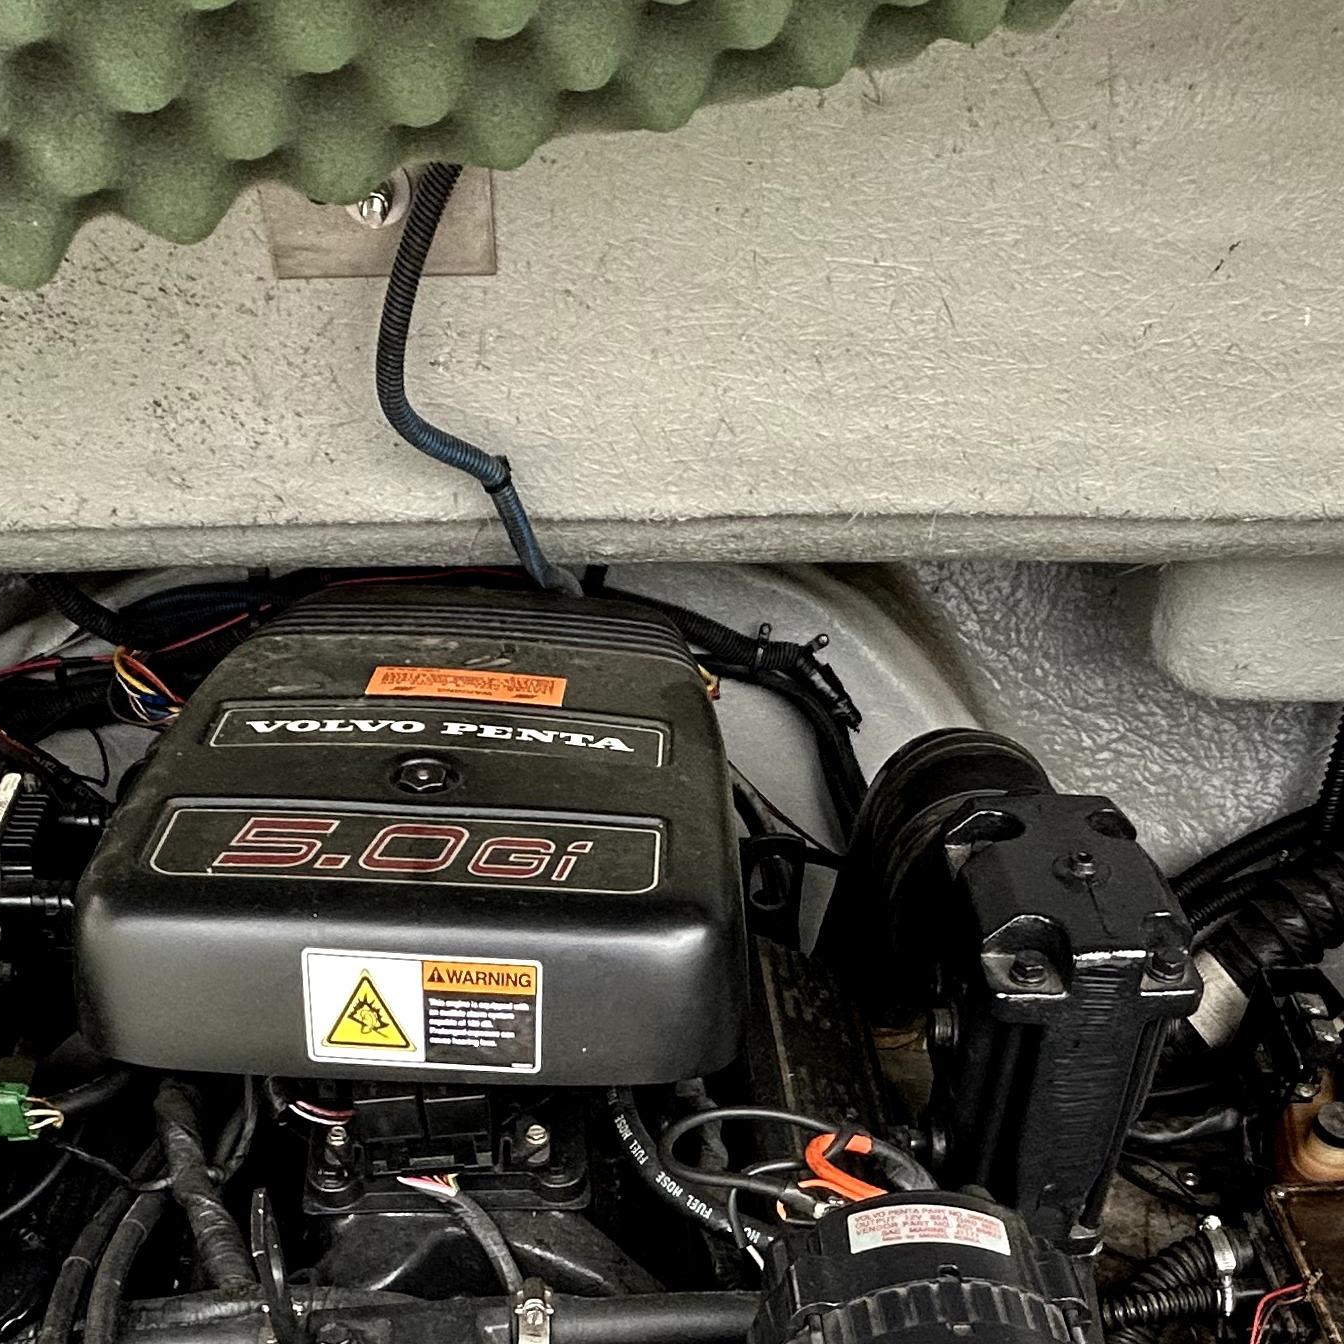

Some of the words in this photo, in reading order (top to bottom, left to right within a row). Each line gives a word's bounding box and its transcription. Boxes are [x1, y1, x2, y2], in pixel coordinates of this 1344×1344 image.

[246, 719, 426, 735] VOLVO
[440, 721, 635, 753] PENTA
[212, 816, 594, 882] 5.0Gi
[445, 969, 532, 988] WARNING
[614, 1113, 633, 1141] HOSE
[628, 1139, 649, 1166] FUEL
[655, 1170, 684, 1198] HOSE
[686, 1194, 713, 1220] FUEL
[855, 1211, 886, 1223] VOLVO
[888, 1208, 920, 1216] PENTA
